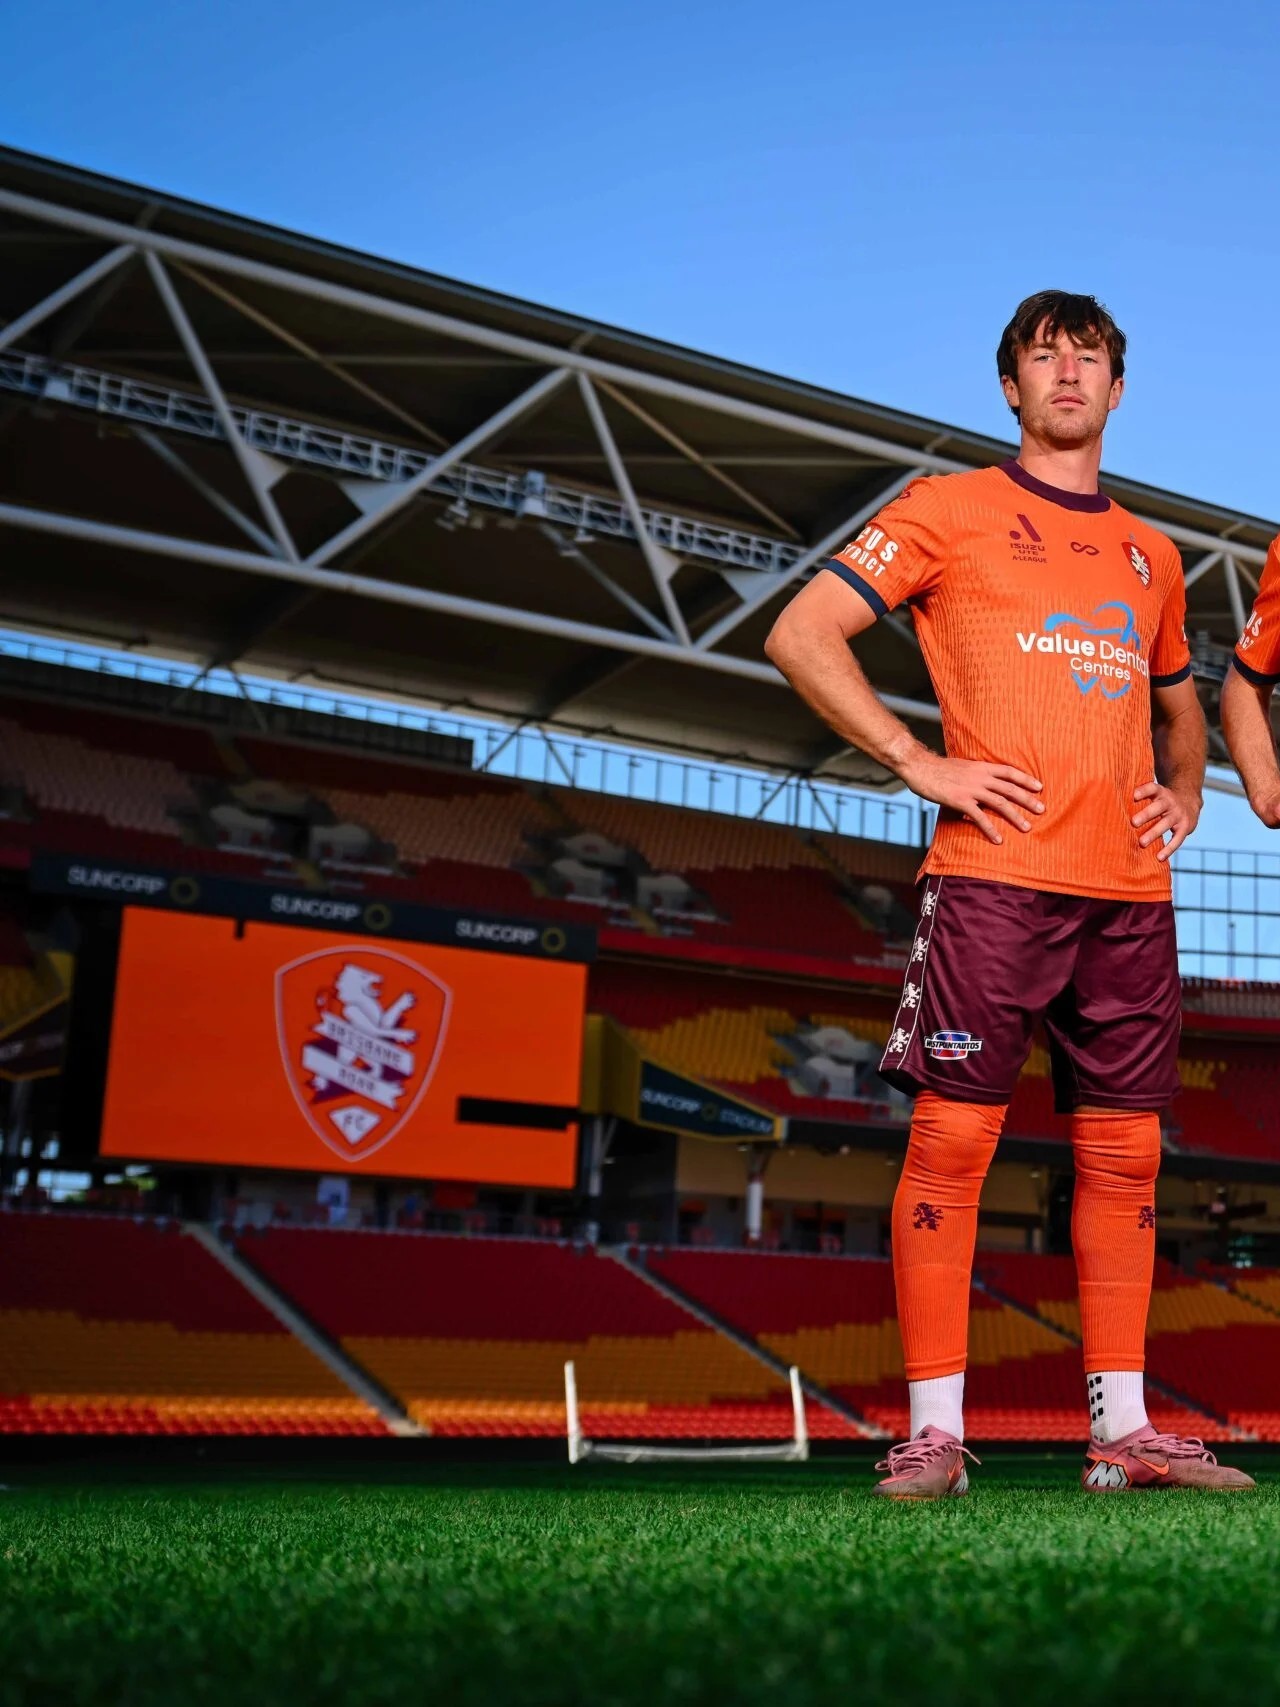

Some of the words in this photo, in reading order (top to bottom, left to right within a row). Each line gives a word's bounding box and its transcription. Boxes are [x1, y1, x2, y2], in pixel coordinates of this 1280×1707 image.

[1010, 543, 1045, 552] ISUZU
[1016, 633, 1096, 657] Value
[1100, 640, 1149, 679] Dental
[1070, 656, 1131, 681] Centres
[67, 865, 166, 897] SUNCORP
[270, 894, 361, 923] SUNCORP
[455, 919, 539, 946] SUNCORP
[343, 1113, 366, 1132] FC
